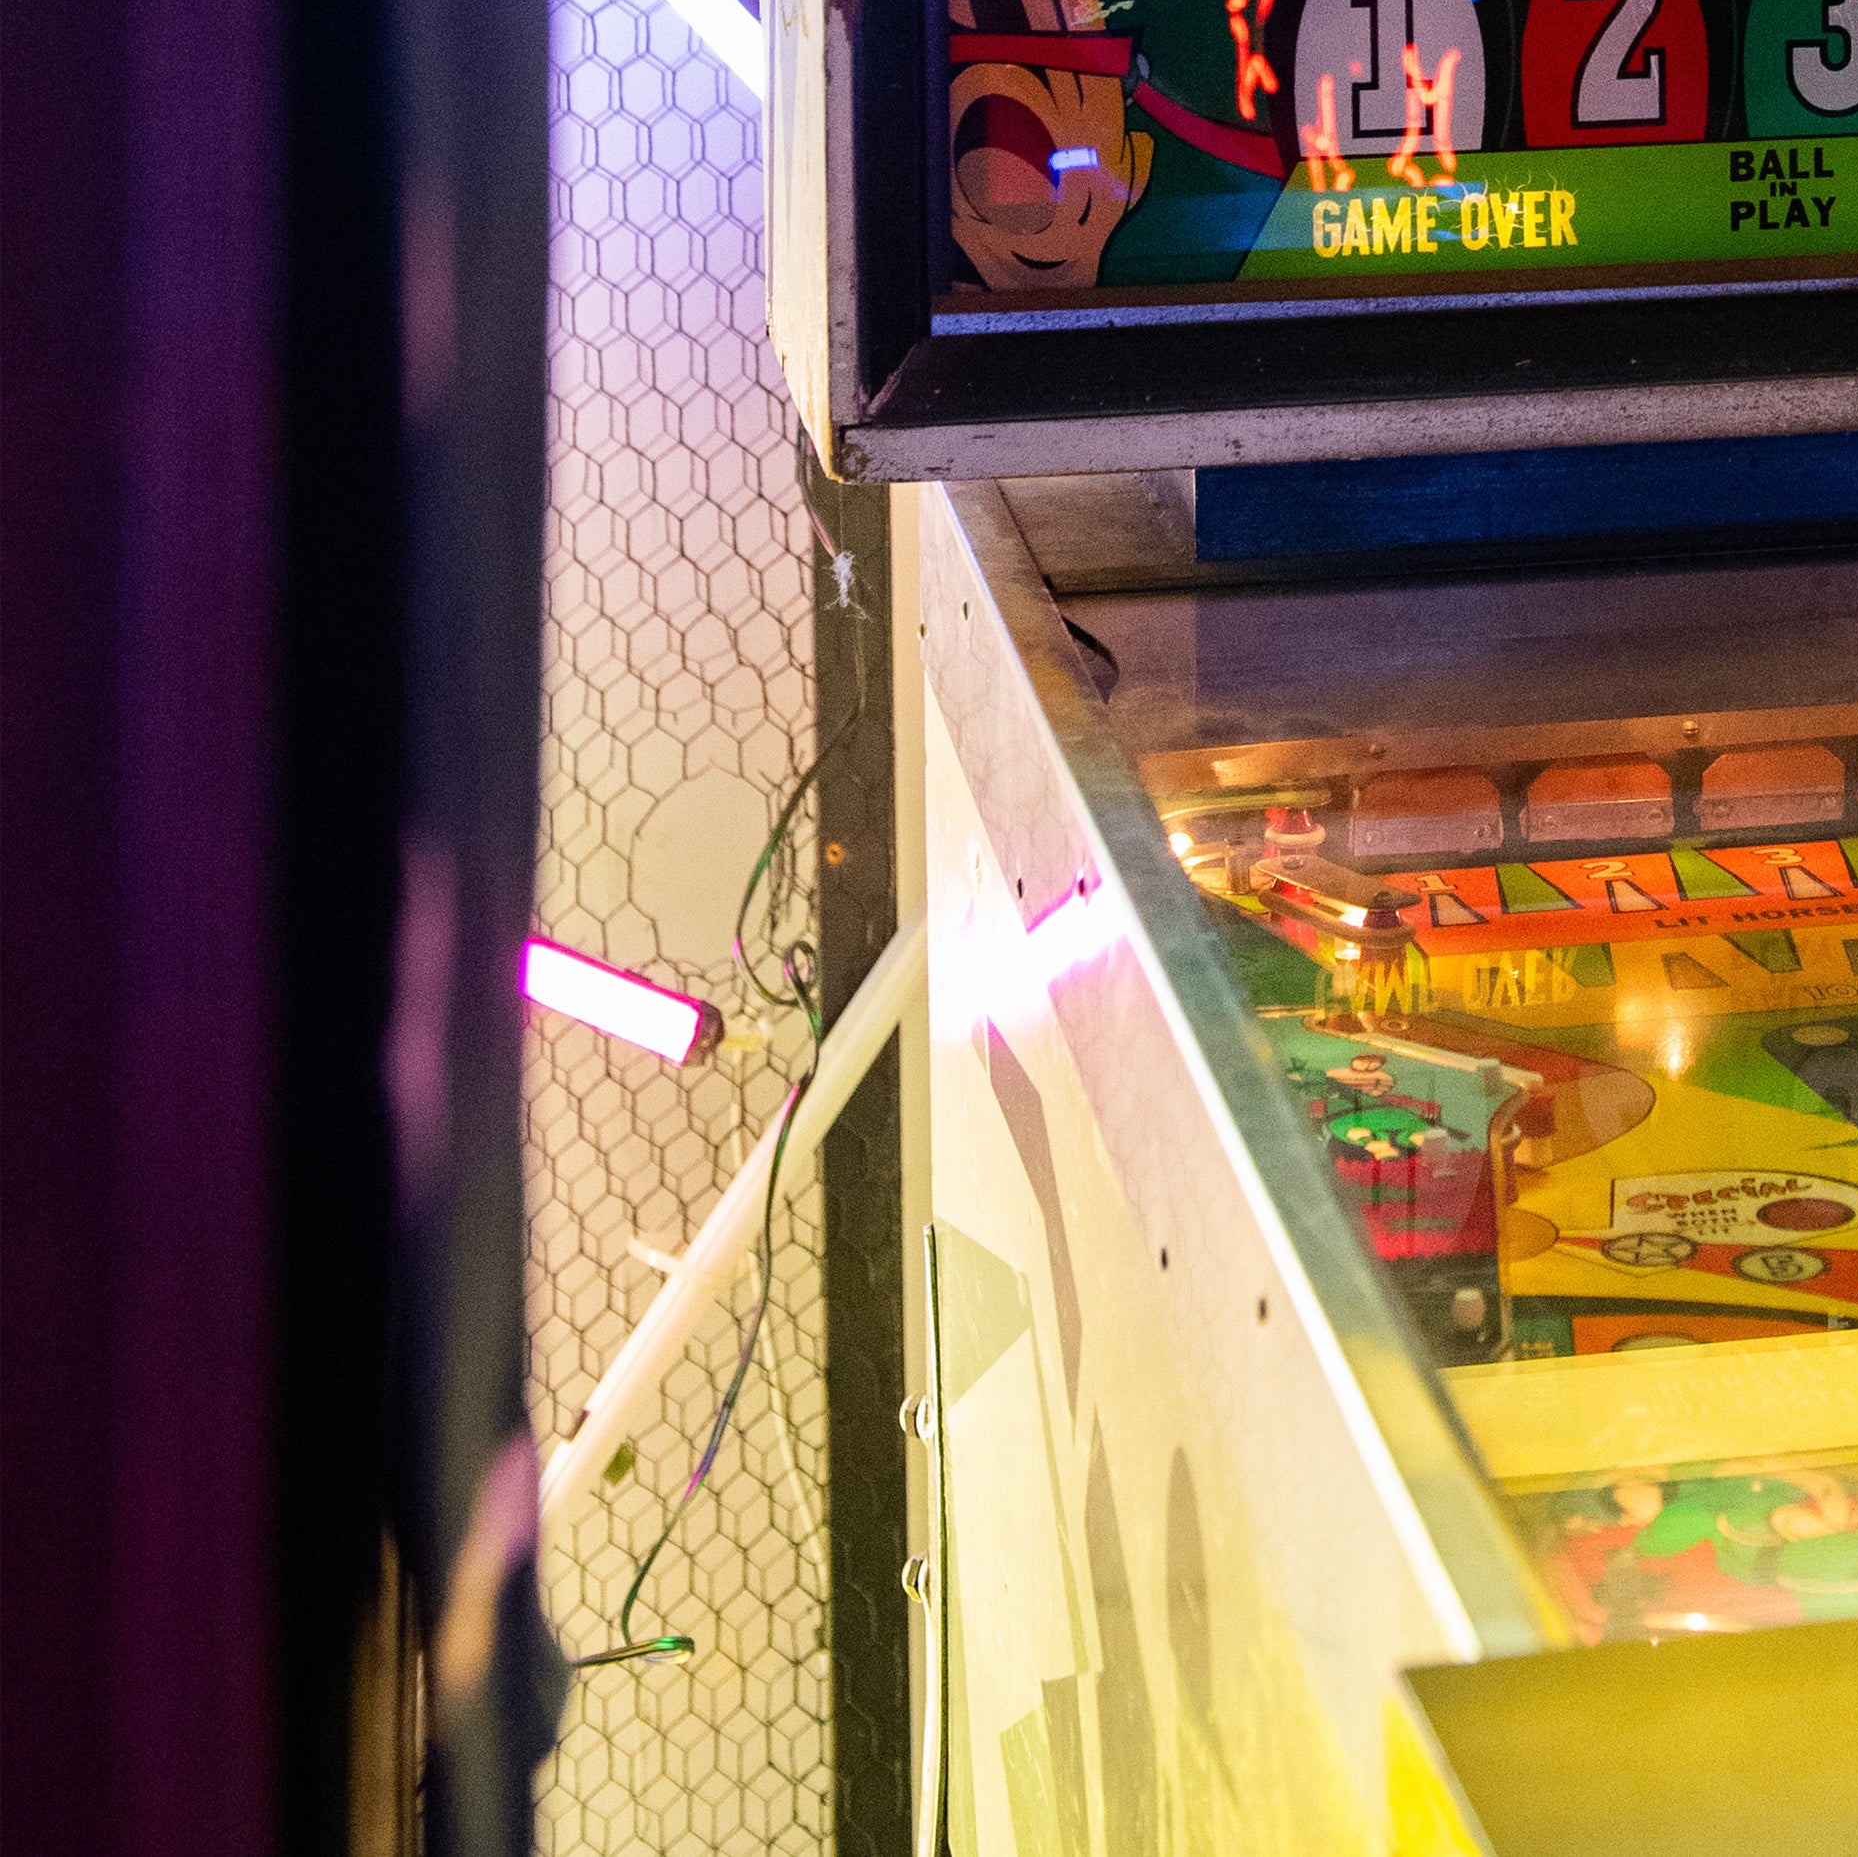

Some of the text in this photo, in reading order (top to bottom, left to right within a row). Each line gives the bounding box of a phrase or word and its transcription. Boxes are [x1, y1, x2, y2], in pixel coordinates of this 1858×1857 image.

[1730, 148, 1835, 183] BALL
[1769, 183, 1797, 197] IN
[1730, 198, 1837, 232] PLAY
[1312, 189, 1579, 260] GAME OVER
[1754, 848, 1805, 866] 3
[1581, 861, 1633, 879] 2
[1416, 874, 1457, 892] 1
[1655, 914, 1713, 928] LIT
